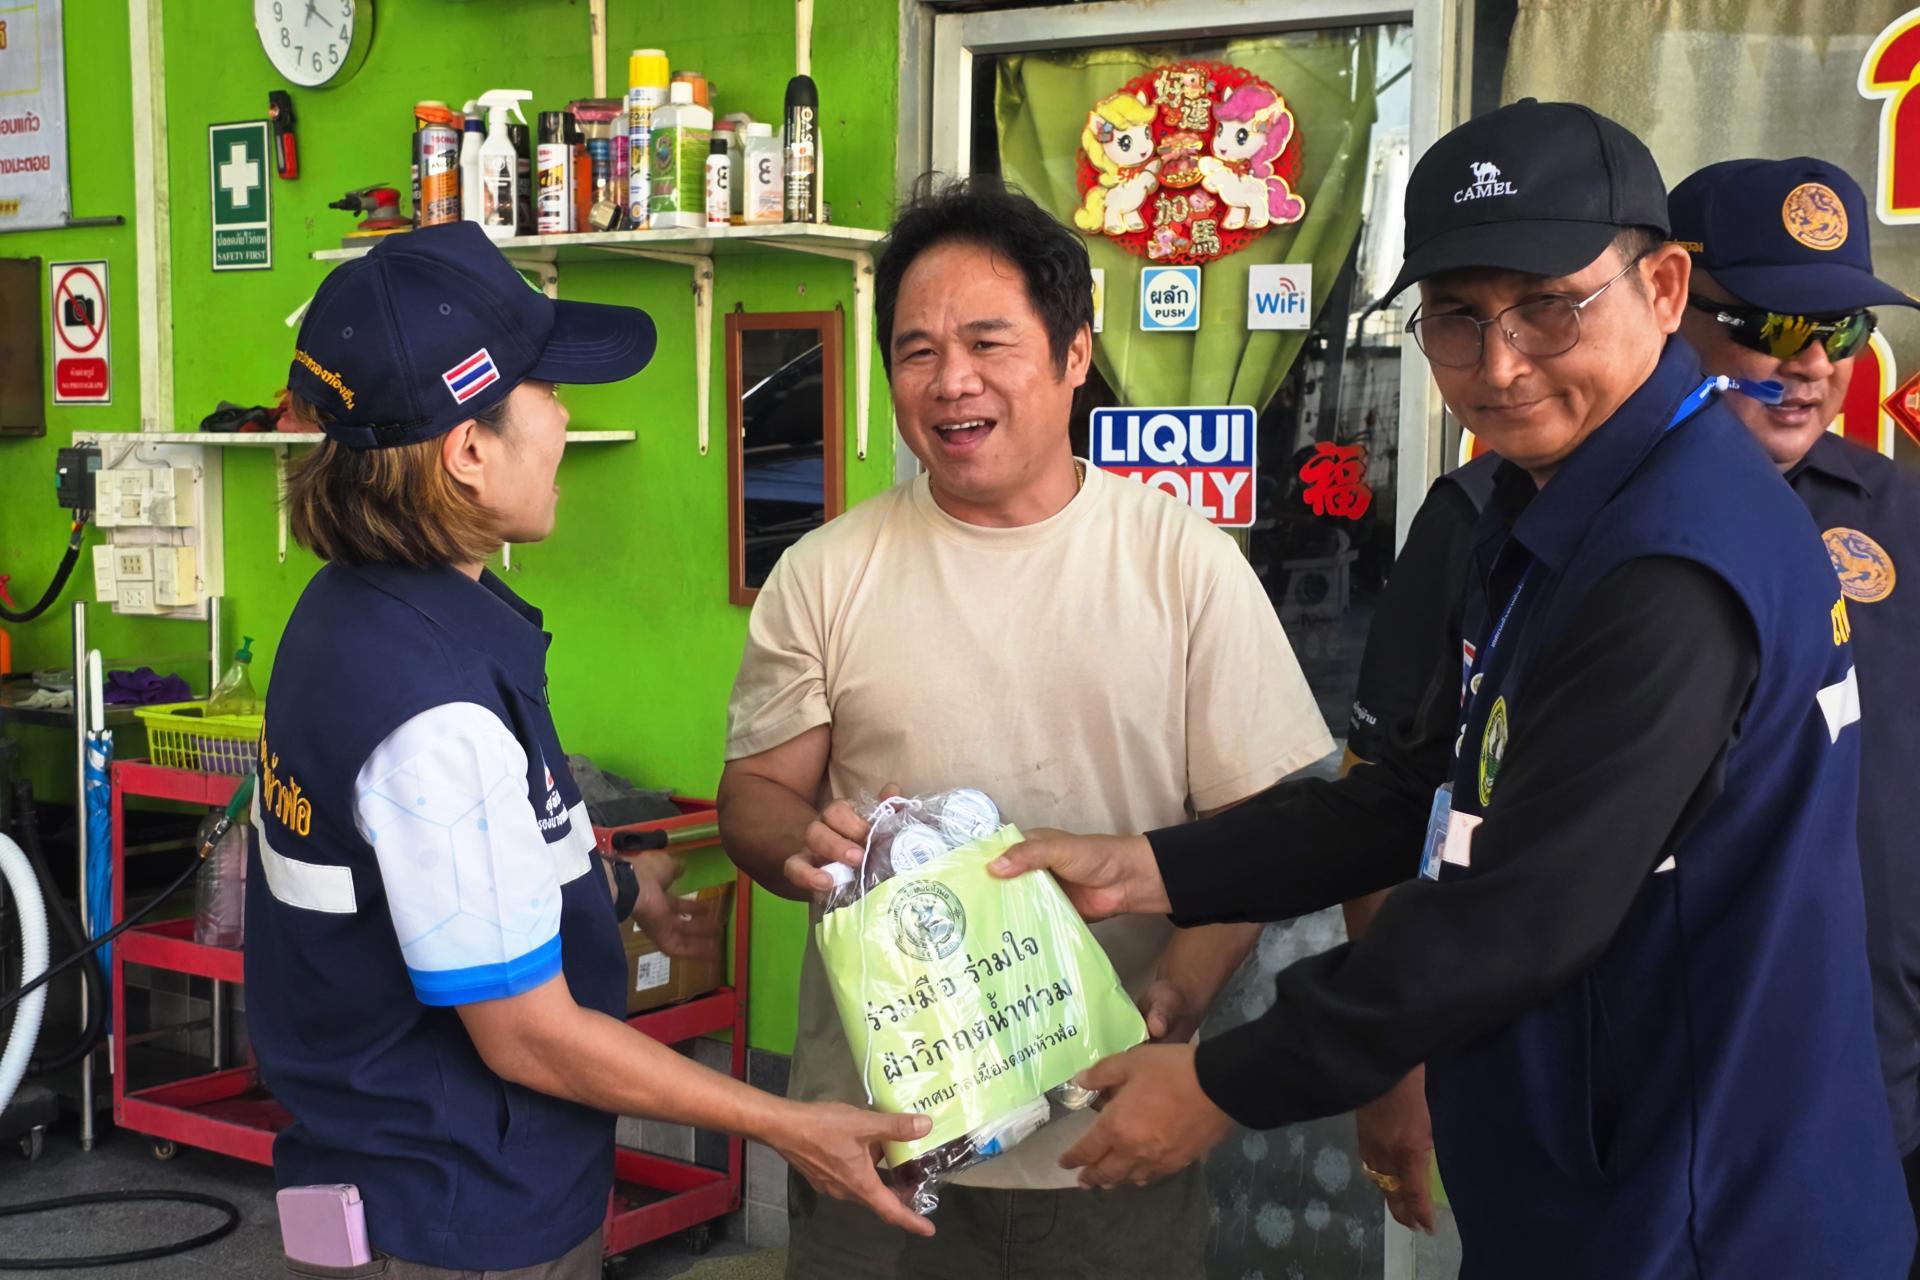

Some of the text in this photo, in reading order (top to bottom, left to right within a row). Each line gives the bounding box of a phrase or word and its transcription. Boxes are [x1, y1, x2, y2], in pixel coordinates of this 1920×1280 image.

[273, 1, 283, 22] 9
[281, 27, 290, 48] 8
[339, 24, 349, 44] 4
[294, 46, 303, 66] 7
[312, 52, 322, 72] 6
[328, 44, 339, 64] 5
[1453, 181, 1518, 203] CAMEL
[217, 250, 266, 261] SAFETY FIRST
[1150, 284, 1189, 304] ผลัก
[1255, 291, 1305, 314] WiFi
[1154, 308, 1186, 319] PUSH
[1101, 414, 1245, 465] LIQUI
[1300, 441, 1373, 520] 福
[1126, 471, 1250, 519] OLY
[964, 930, 1039, 984] ร่วมใจ
